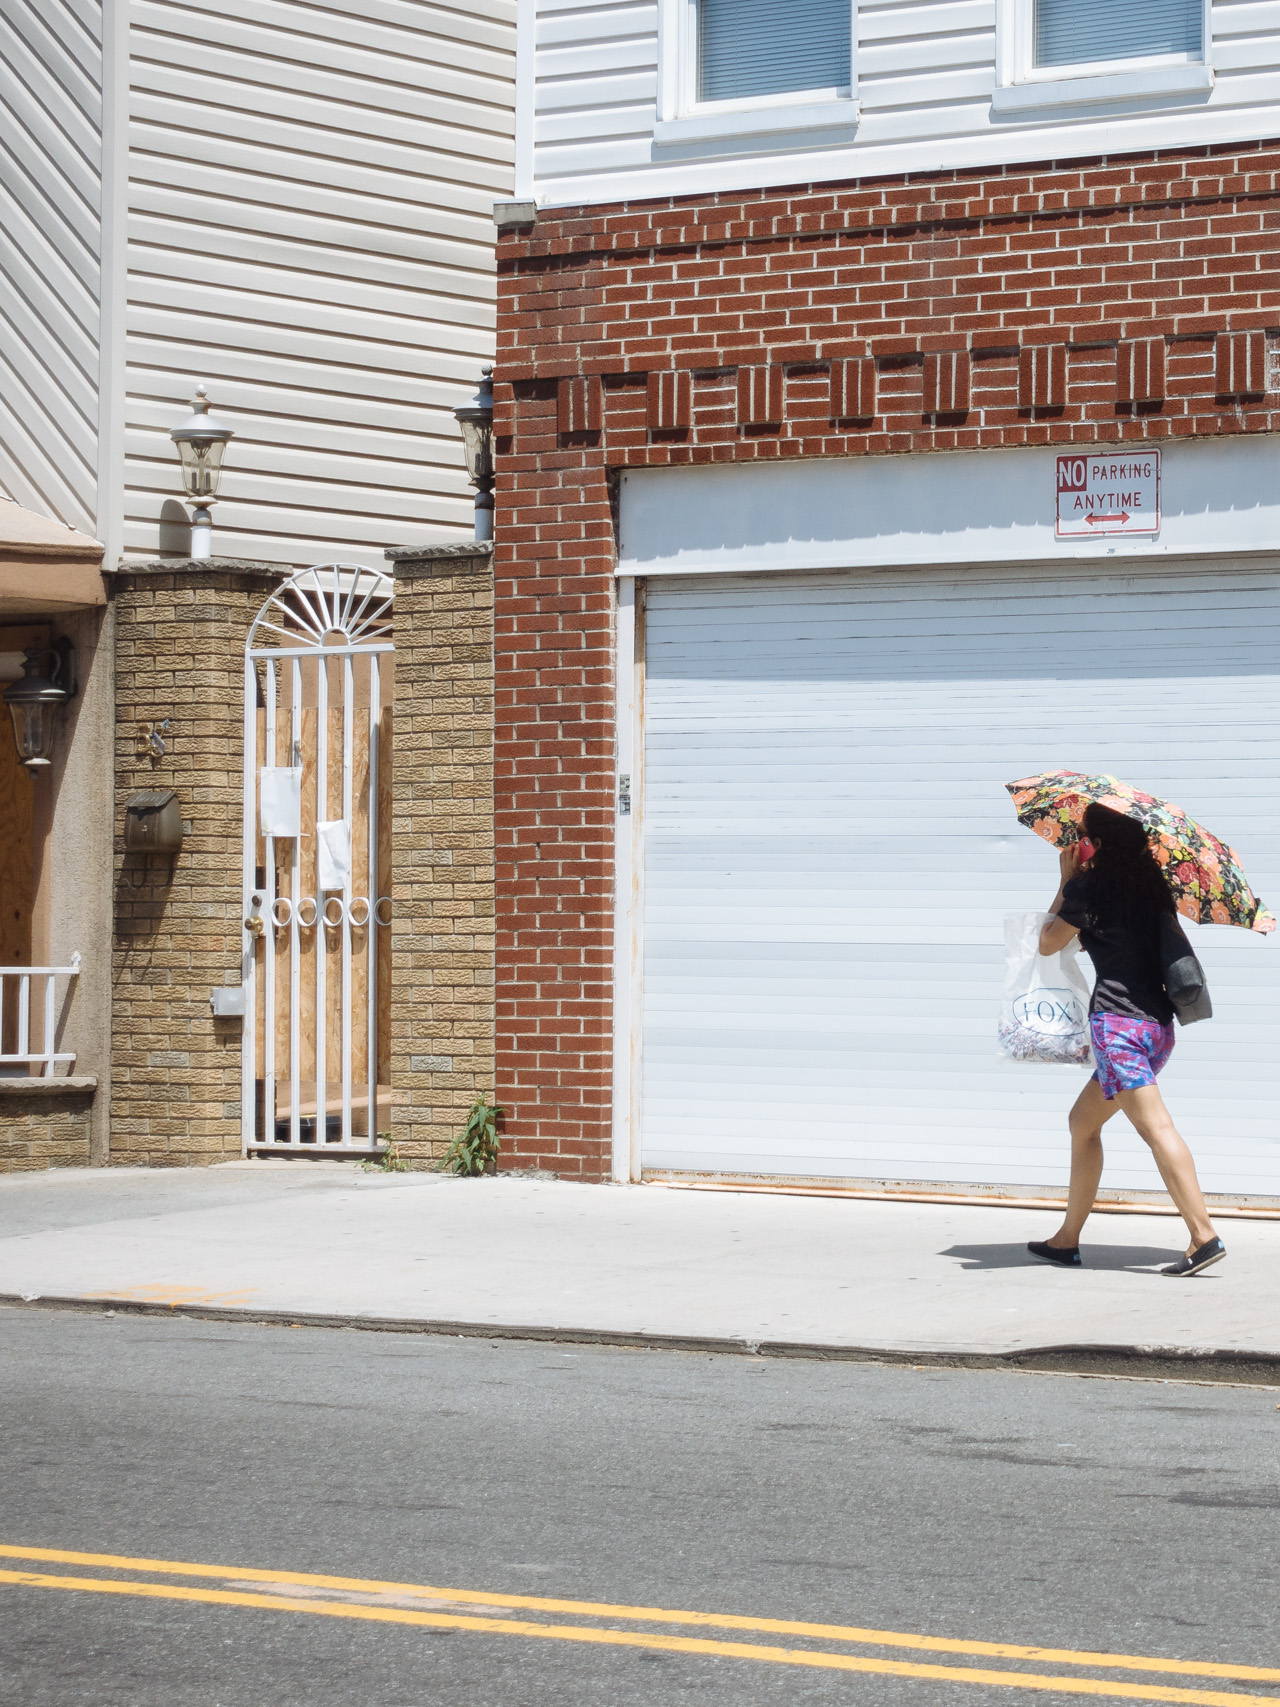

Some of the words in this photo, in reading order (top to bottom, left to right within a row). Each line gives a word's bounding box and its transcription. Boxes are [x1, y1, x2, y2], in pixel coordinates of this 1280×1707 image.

[1059, 460, 1086, 487] NO
[1092, 463, 1151, 480] PARKING
[1073, 492, 1142, 510] ANYTIME
[1023, 1000, 1083, 1023] FOX'
